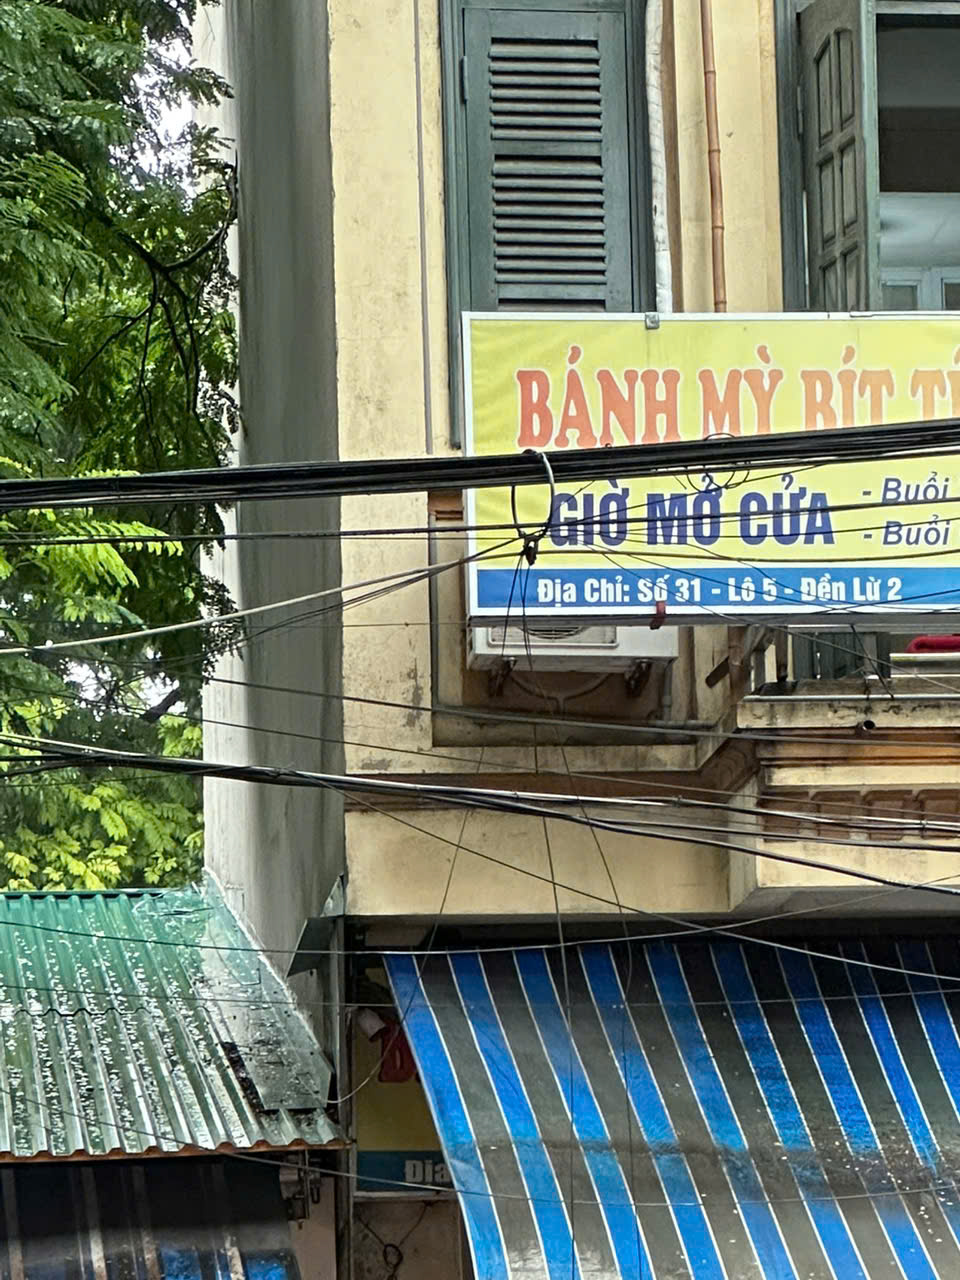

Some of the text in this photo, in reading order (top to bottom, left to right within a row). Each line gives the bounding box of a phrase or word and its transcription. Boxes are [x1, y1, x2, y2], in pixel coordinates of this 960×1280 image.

[516, 345, 681, 449] BÁNH
[698, 345, 784, 438] MỲ
[800, 345, 895, 431] BÍT
[882, 472, 949, 504] Buổi
[550, 474, 835, 546] GIỜ MỞ CỬA
[882, 514, 950, 546] Buổi
[537, 577, 577, 607] Địa
[583, 575, 630, 602] Chỉ:
[637, 573, 671, 602] Số
[675, 577, 701, 602] 31
[728, 575, 760, 602] Lô
[763, 577, 777, 602] 5
[800, 572, 846, 602] Đền
[853, 575, 882, 601] Lừ
[887, 576, 903, 601] 2
